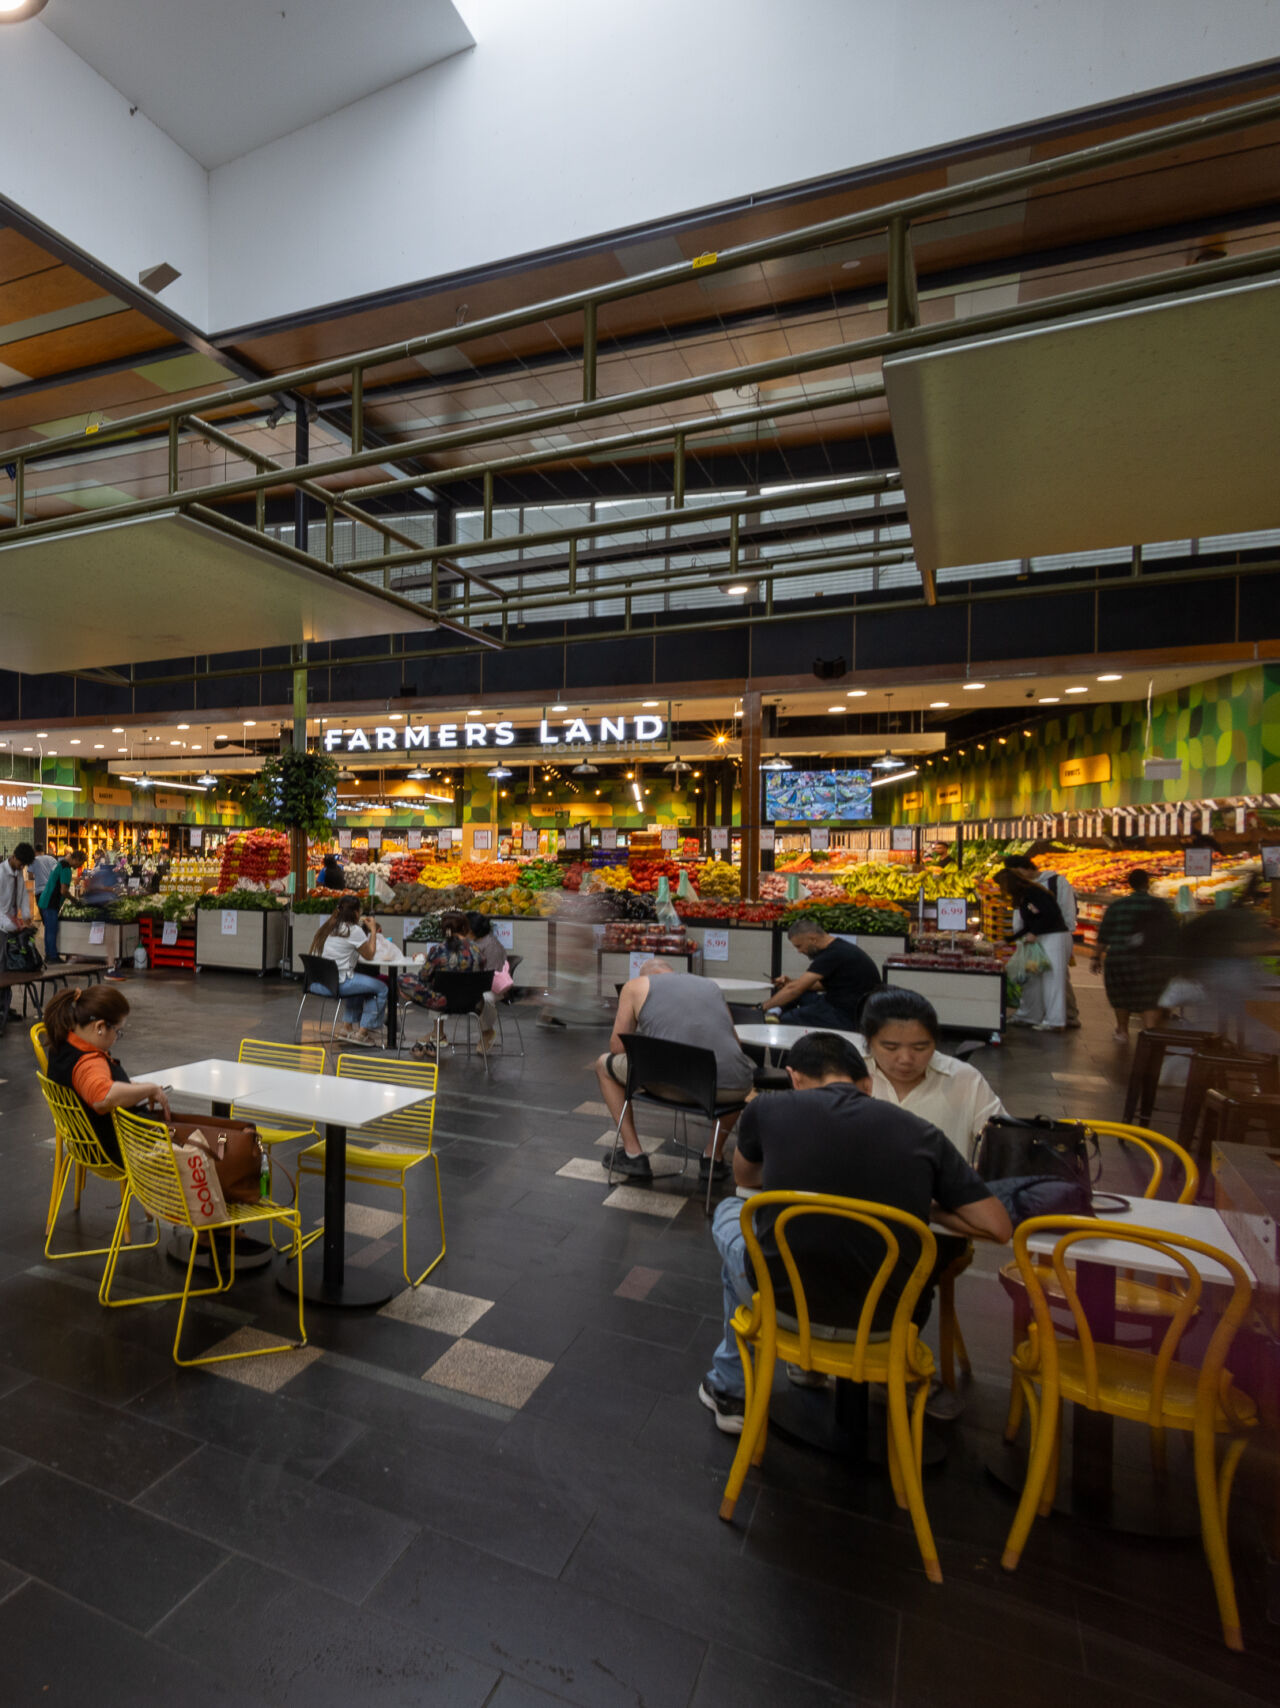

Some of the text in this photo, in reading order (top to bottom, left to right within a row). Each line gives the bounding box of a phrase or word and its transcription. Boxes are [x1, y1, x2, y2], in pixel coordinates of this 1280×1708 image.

[324, 715, 664, 751] FARMERS LAND
[542, 739, 661, 753] ROUSE HILL
[6, 795, 28, 808] LAND
[187, 1155, 215, 1217] coles
